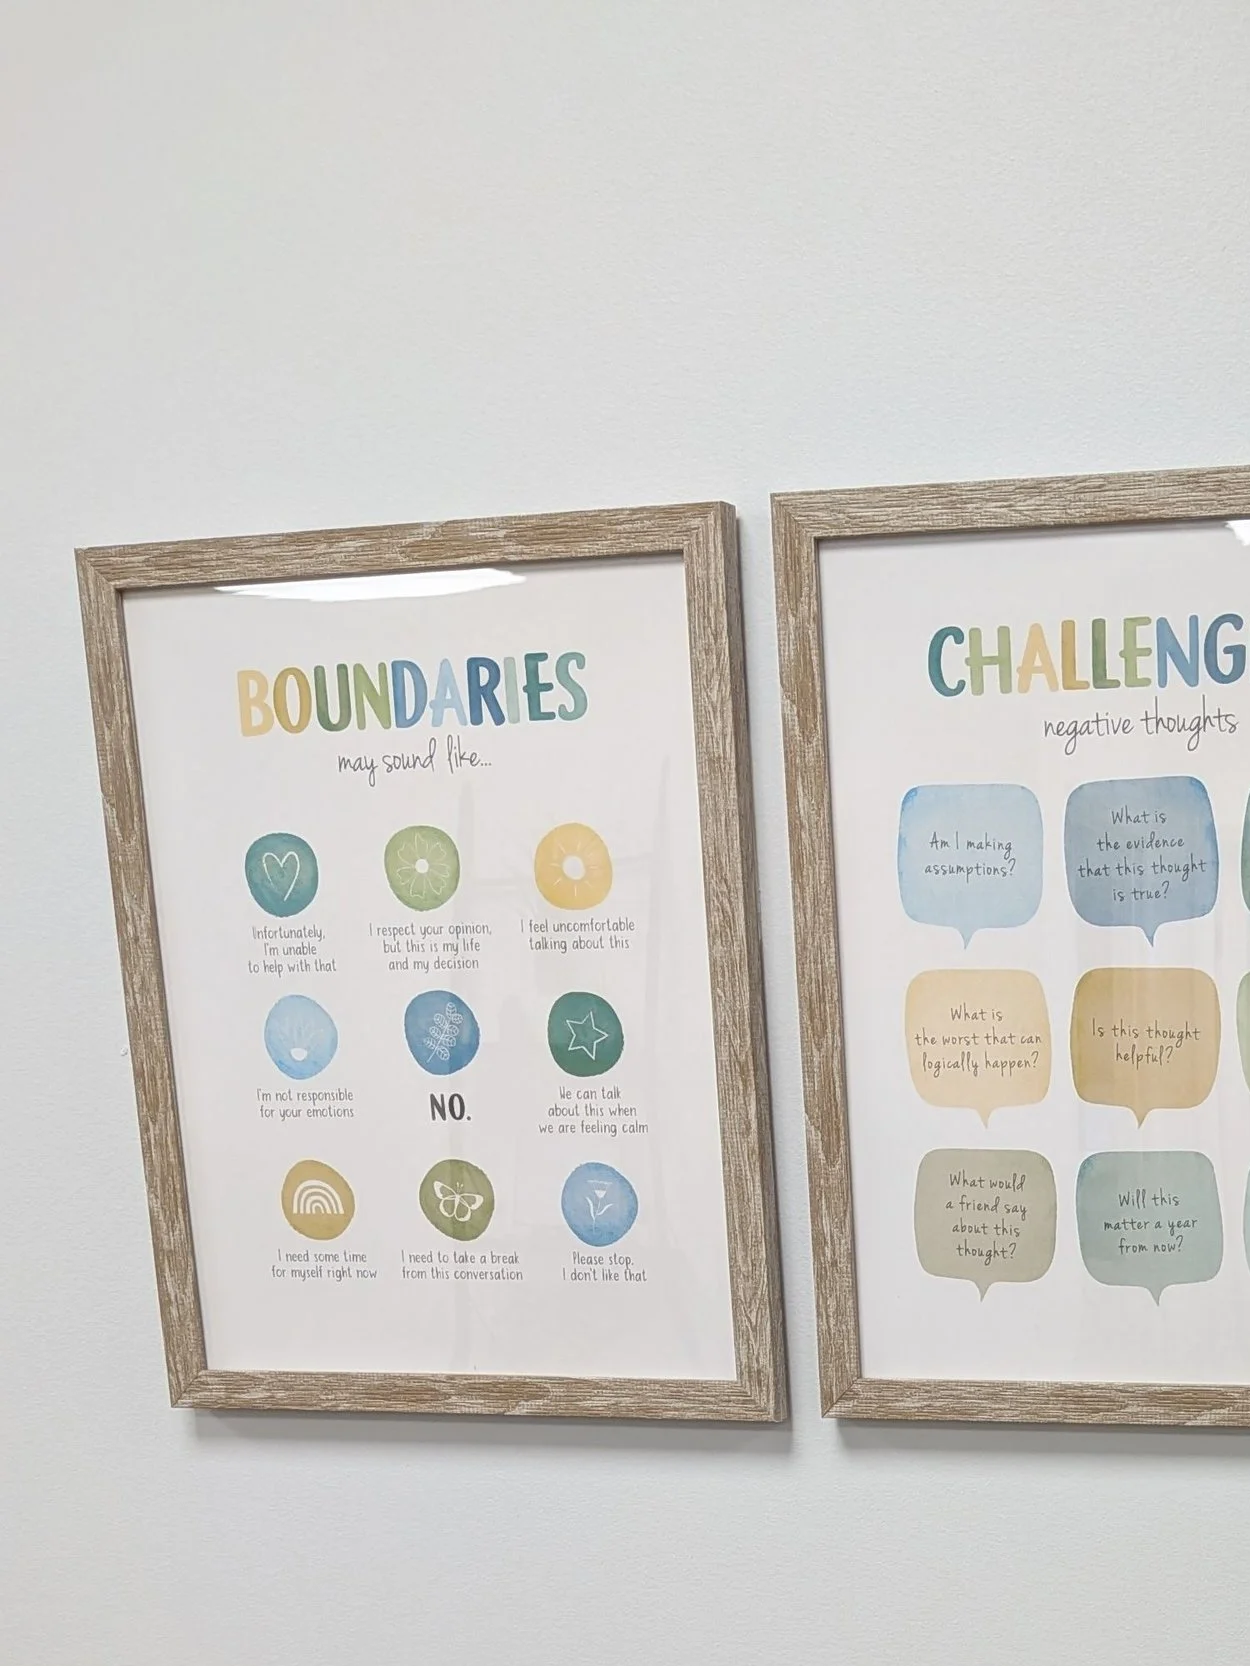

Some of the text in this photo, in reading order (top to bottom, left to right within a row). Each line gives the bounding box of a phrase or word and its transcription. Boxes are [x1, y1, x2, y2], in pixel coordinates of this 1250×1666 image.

[237, 652, 588, 737] BOUNDARIES
[1043, 693, 1240, 756] negative thoughts
[337, 733, 492, 787] may sound like...
[1110, 804, 1168, 825] What is
[928, 830, 1013, 861] Am I making
[1096, 830, 1185, 852] the evidence
[924, 857, 1017, 884] assumptions?
[1077, 852, 1208, 883] that this thought
[1112, 880, 1170, 903] is true?
[369, 922, 492, 942] I respect your opinion,
[520, 916, 636, 934] I feel uncomfortable
[263, 941, 317, 957] I'm unable
[382, 937, 481, 957] but this is my life
[528, 934, 630, 955] talking about this
[247, 958, 337, 979] to help with that
[388, 955, 479, 975] and my decision
[1092, 1017, 1201, 1049] Is this thought
[1115, 1042, 1174, 1071] helpful?
[256, 1087, 354, 1107] I'm not responsible
[429, 1092, 472, 1122] NO.
[259, 1104, 355, 1122] for your emotions
[1118, 1187, 1180, 1210] Will this
[1103, 1218, 1198, 1237] matter a year
[1117, 1234, 1184, 1256] from now?
[572, 1250, 635, 1270] Please stop.
[562, 1267, 648, 1283] I don't like that
